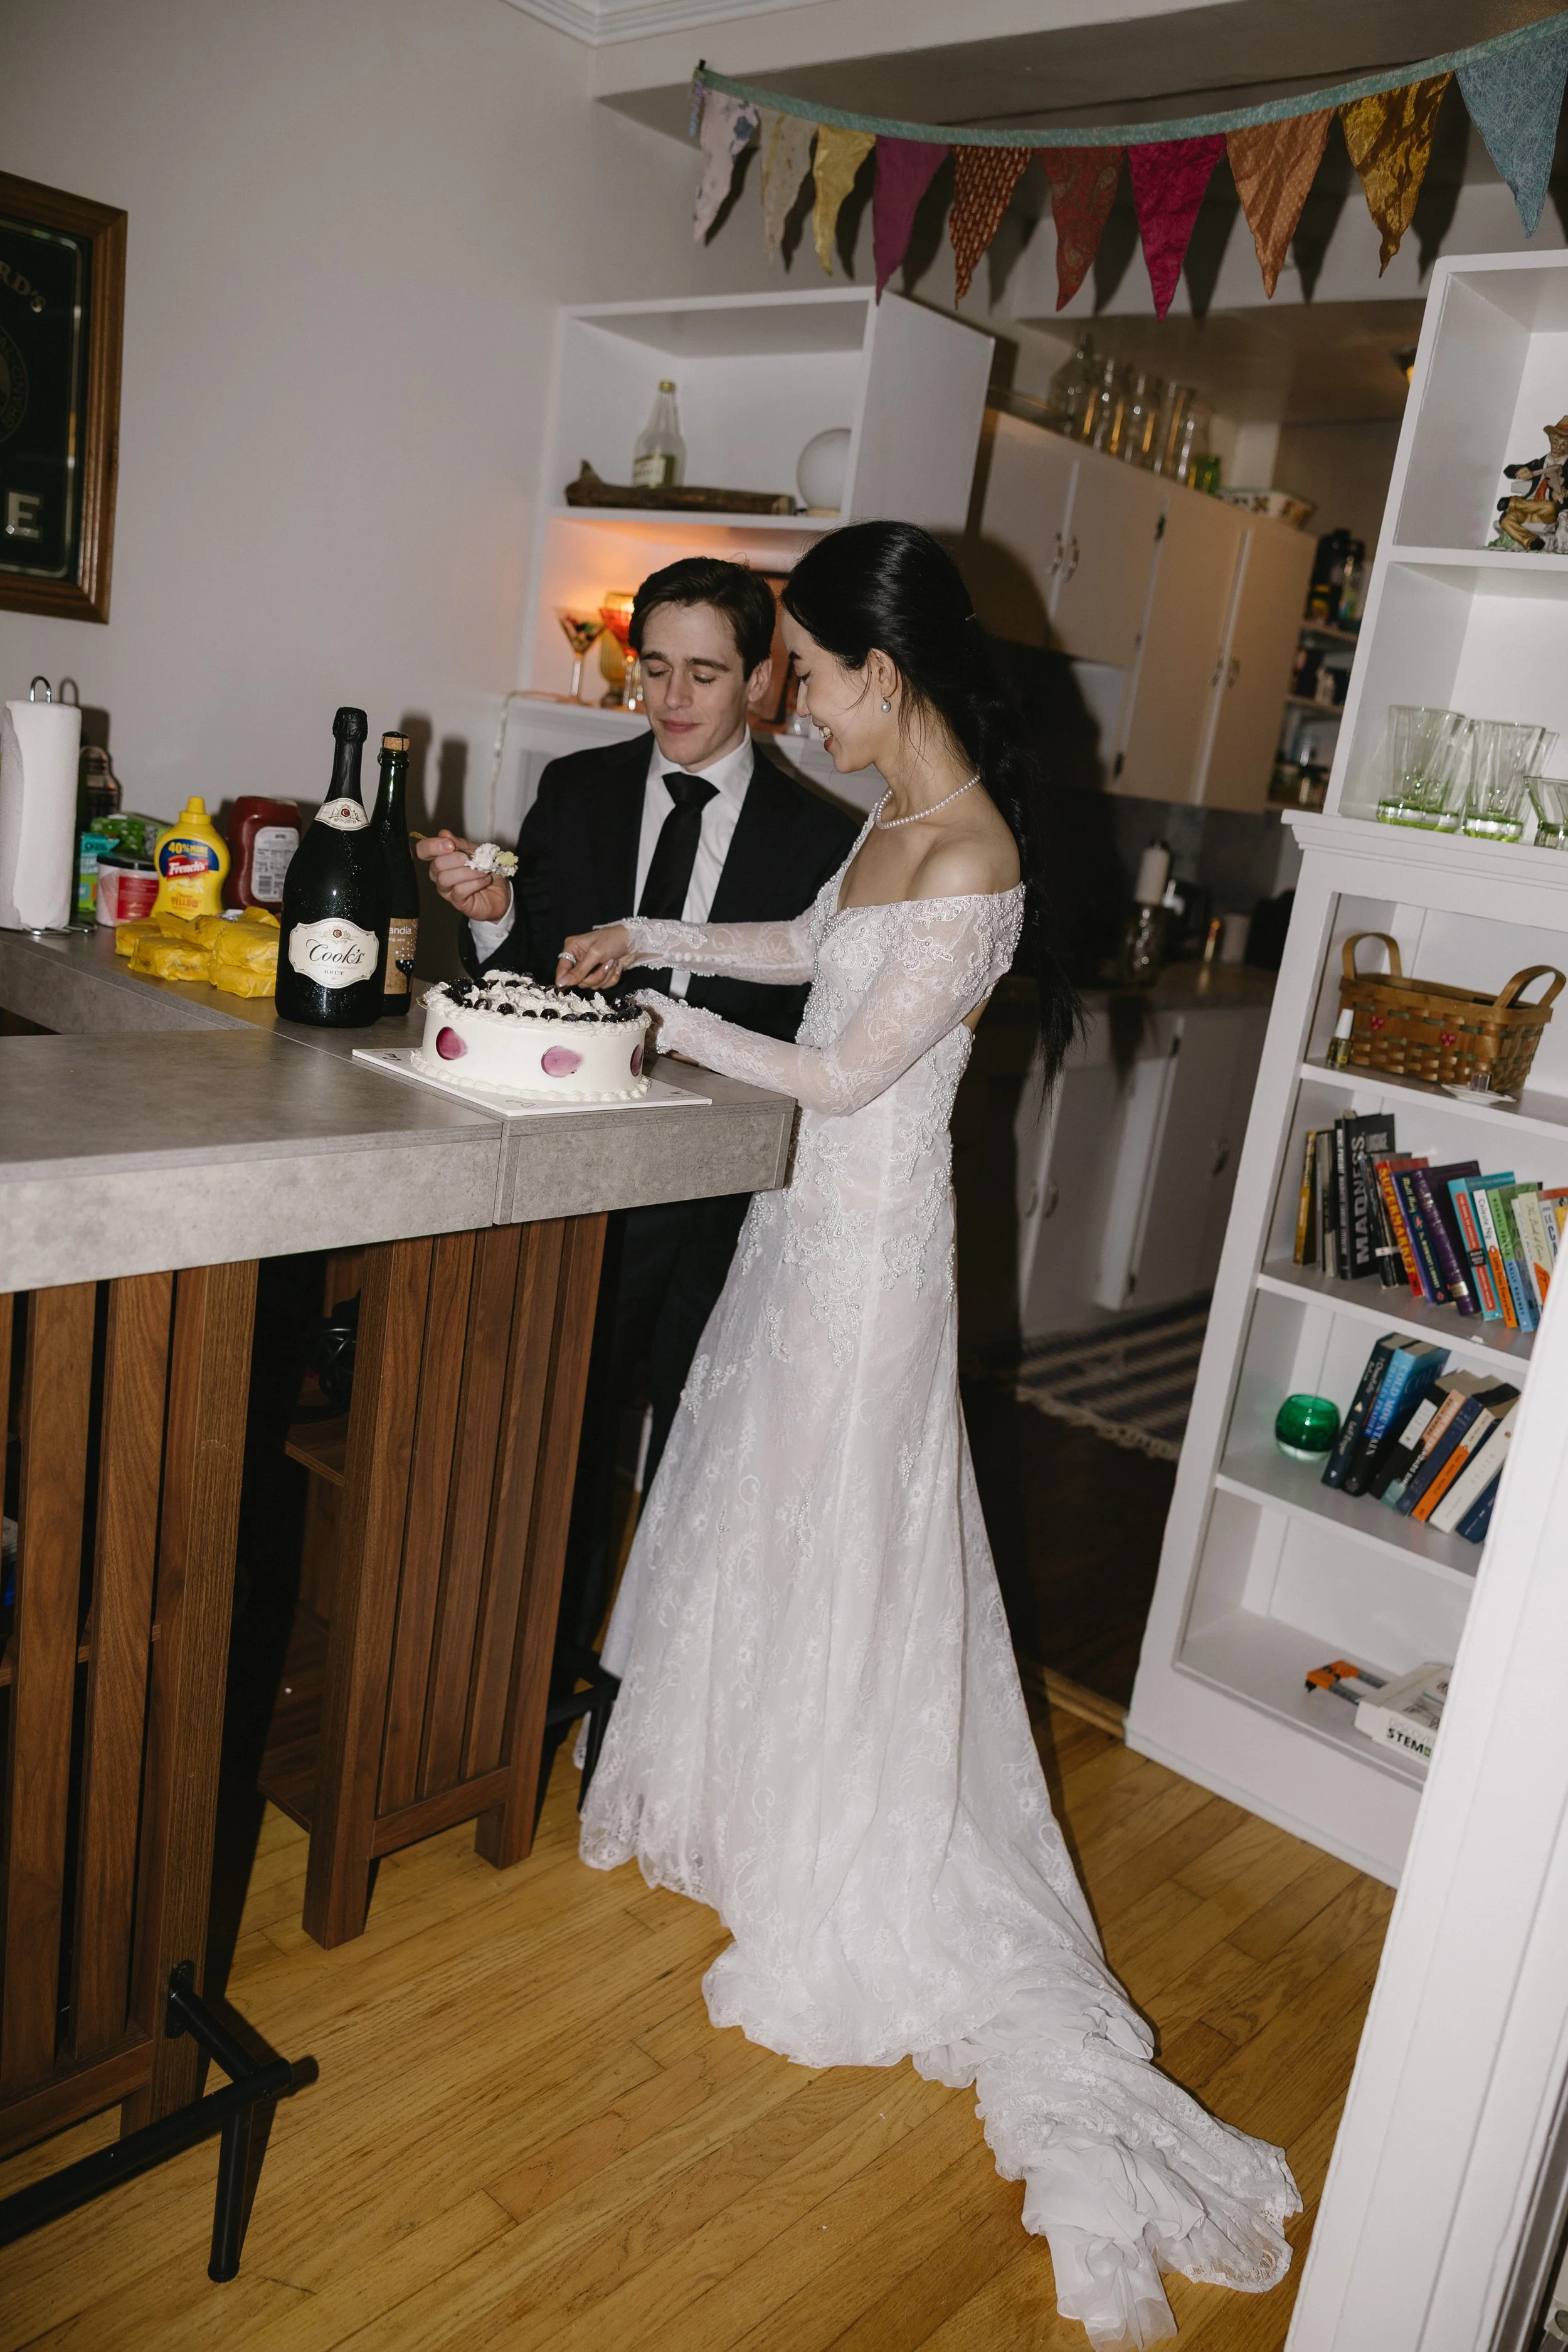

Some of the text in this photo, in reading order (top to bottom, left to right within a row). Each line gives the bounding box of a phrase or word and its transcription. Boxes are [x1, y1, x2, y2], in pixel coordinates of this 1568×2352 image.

[168, 842, 189, 854] 40%
[168, 861, 209, 876] French's
[389, 926, 412, 935] andia
[306, 939, 366, 965] Cook's
[1380, 1167, 1416, 1273] SUPERMARKET
[1482, 1226, 1494, 1239] Ng
[1365, 1364, 1409, 1458] COLD MOUNTAIN
[1387, 1729, 1423, 1754] STEM
